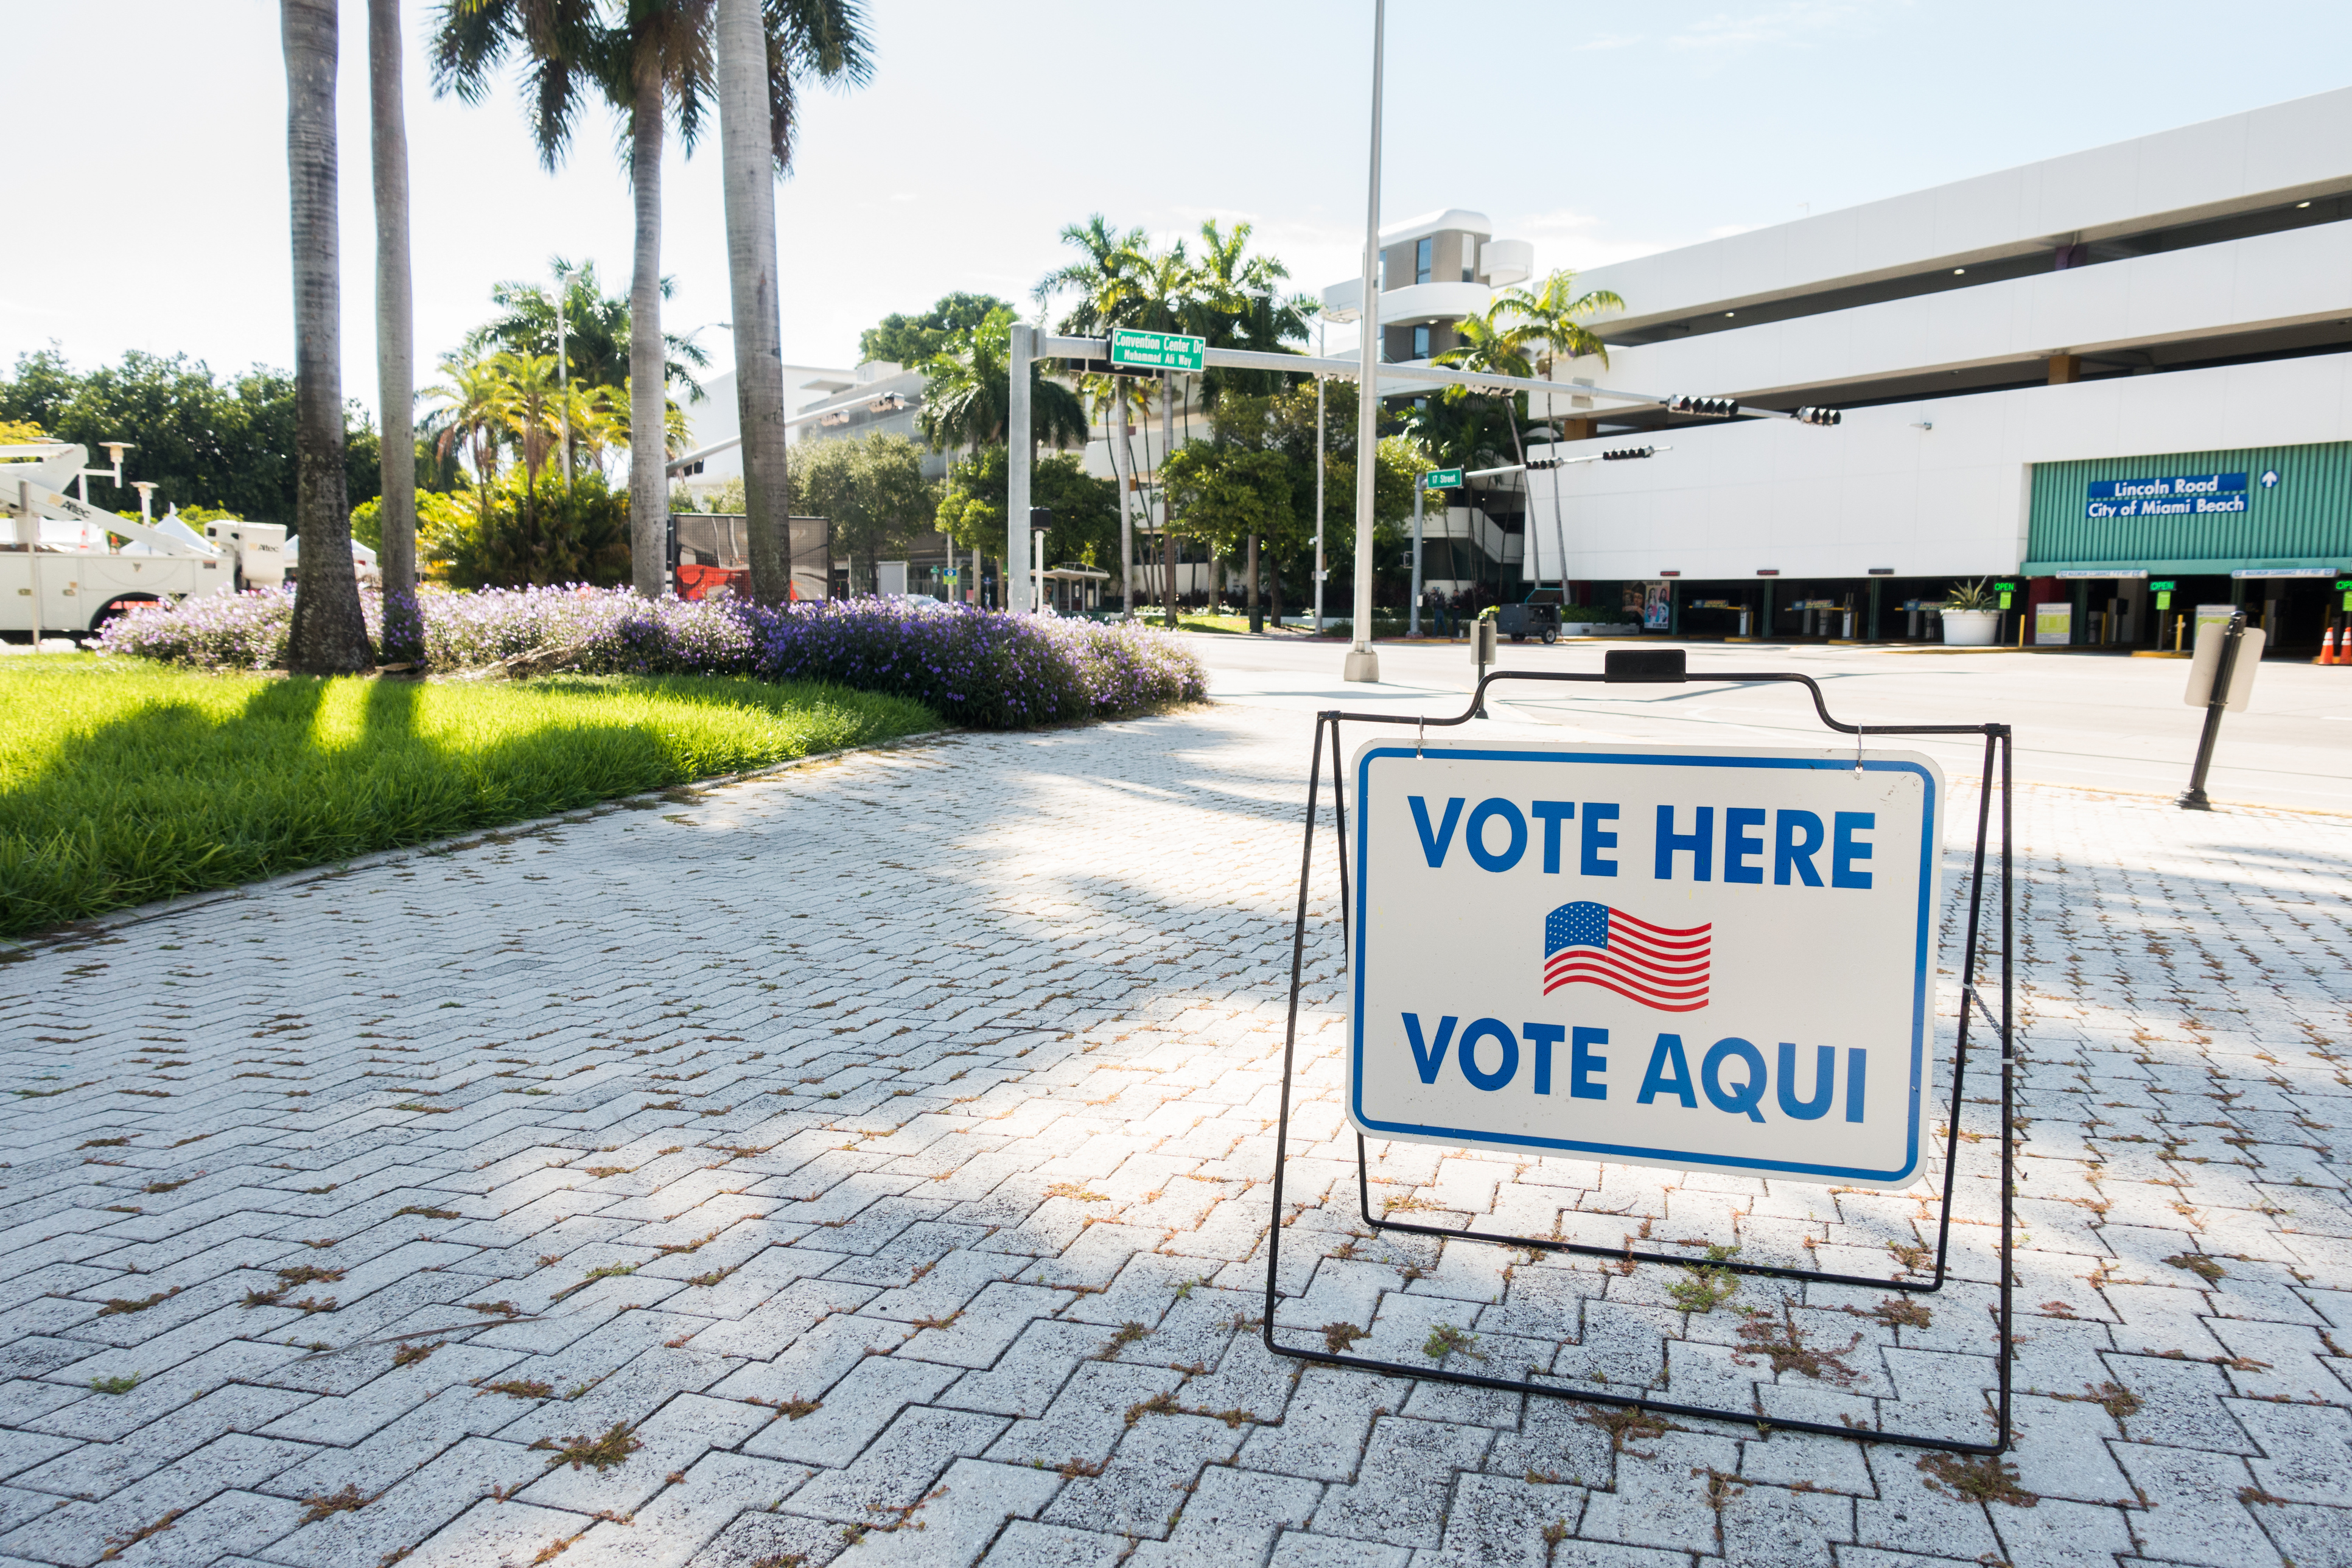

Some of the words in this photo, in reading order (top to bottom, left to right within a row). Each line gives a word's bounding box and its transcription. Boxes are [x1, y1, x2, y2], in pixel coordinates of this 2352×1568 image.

[1115, 332, 1160, 350] Convention
[1163, 337, 1190, 352] Center
[1193, 340, 1203, 354] Dr
[1124, 349, 1161, 363] Muhammad
[1164, 354, 1175, 365] Ali
[1178, 355, 1192, 368] Way
[1432, 475, 1438, 484] 17
[1440, 474, 1456, 483] Street
[2114, 479, 2169, 497] Lincoln
[2174, 475, 2219, 494] Road
[60, 500, 91, 518] Altec
[2088, 502, 2117, 517] City
[2120, 500, 2137, 516] of
[2141, 499, 2191, 515] Miami
[2196, 495, 2244, 513] Beach
[258, 544, 279, 552] Altec
[1994, 583, 2014, 591] OPEN
[2150, 581, 2174, 590] OPEN
[1407, 795, 1620, 878] VOTE
[1654, 805, 1875, 890] HERE
[1401, 1012, 1609, 1101] VOTE
[1636, 1033, 1867, 1124] AQUI
